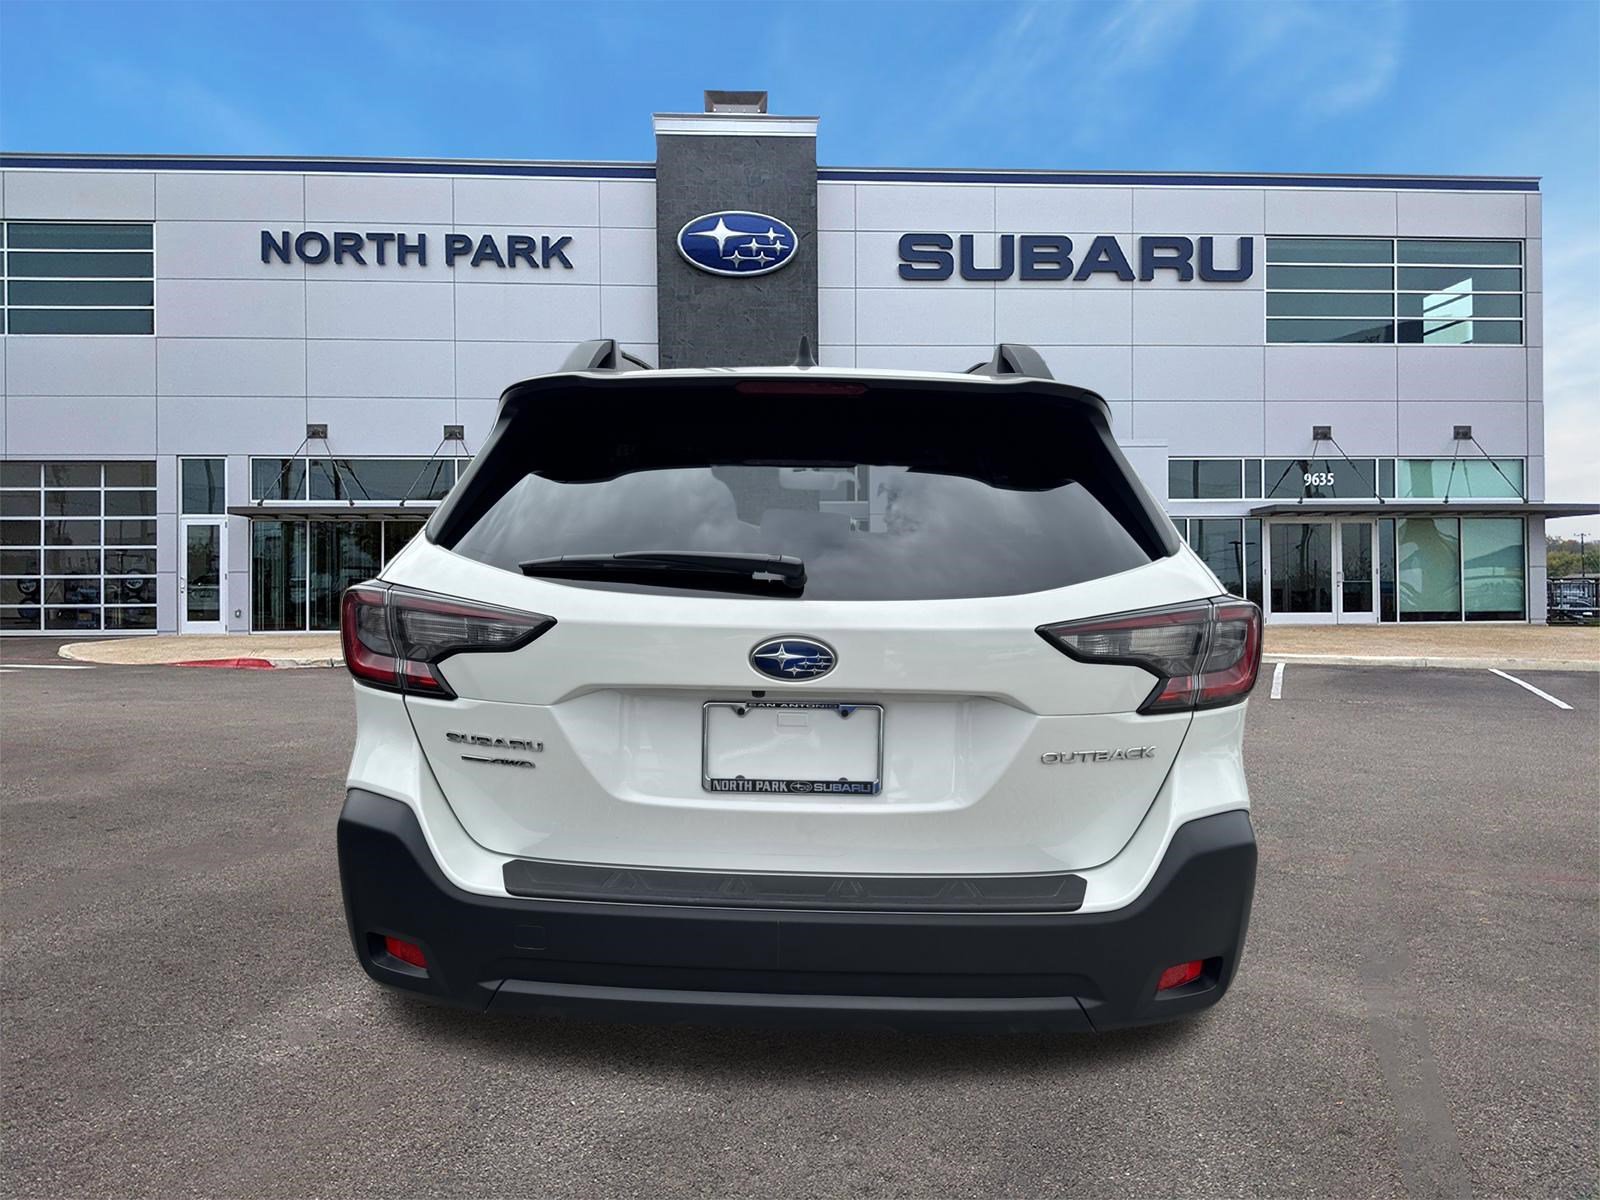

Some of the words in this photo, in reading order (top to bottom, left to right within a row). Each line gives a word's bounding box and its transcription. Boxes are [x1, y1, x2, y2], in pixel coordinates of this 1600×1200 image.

[260, 230, 428, 266] NORTH
[444, 233, 574, 269] PARK
[898, 233, 1254, 282] SUBARU
[1303, 472, 1335, 486] 9635
[446, 732, 544, 752] SUBARU
[1041, 746, 1156, 765] OUTBACK
[712, 780, 752, 792] NORTH
[755, 781, 788, 793] PARK
[813, 783, 871, 793] SUBARU
